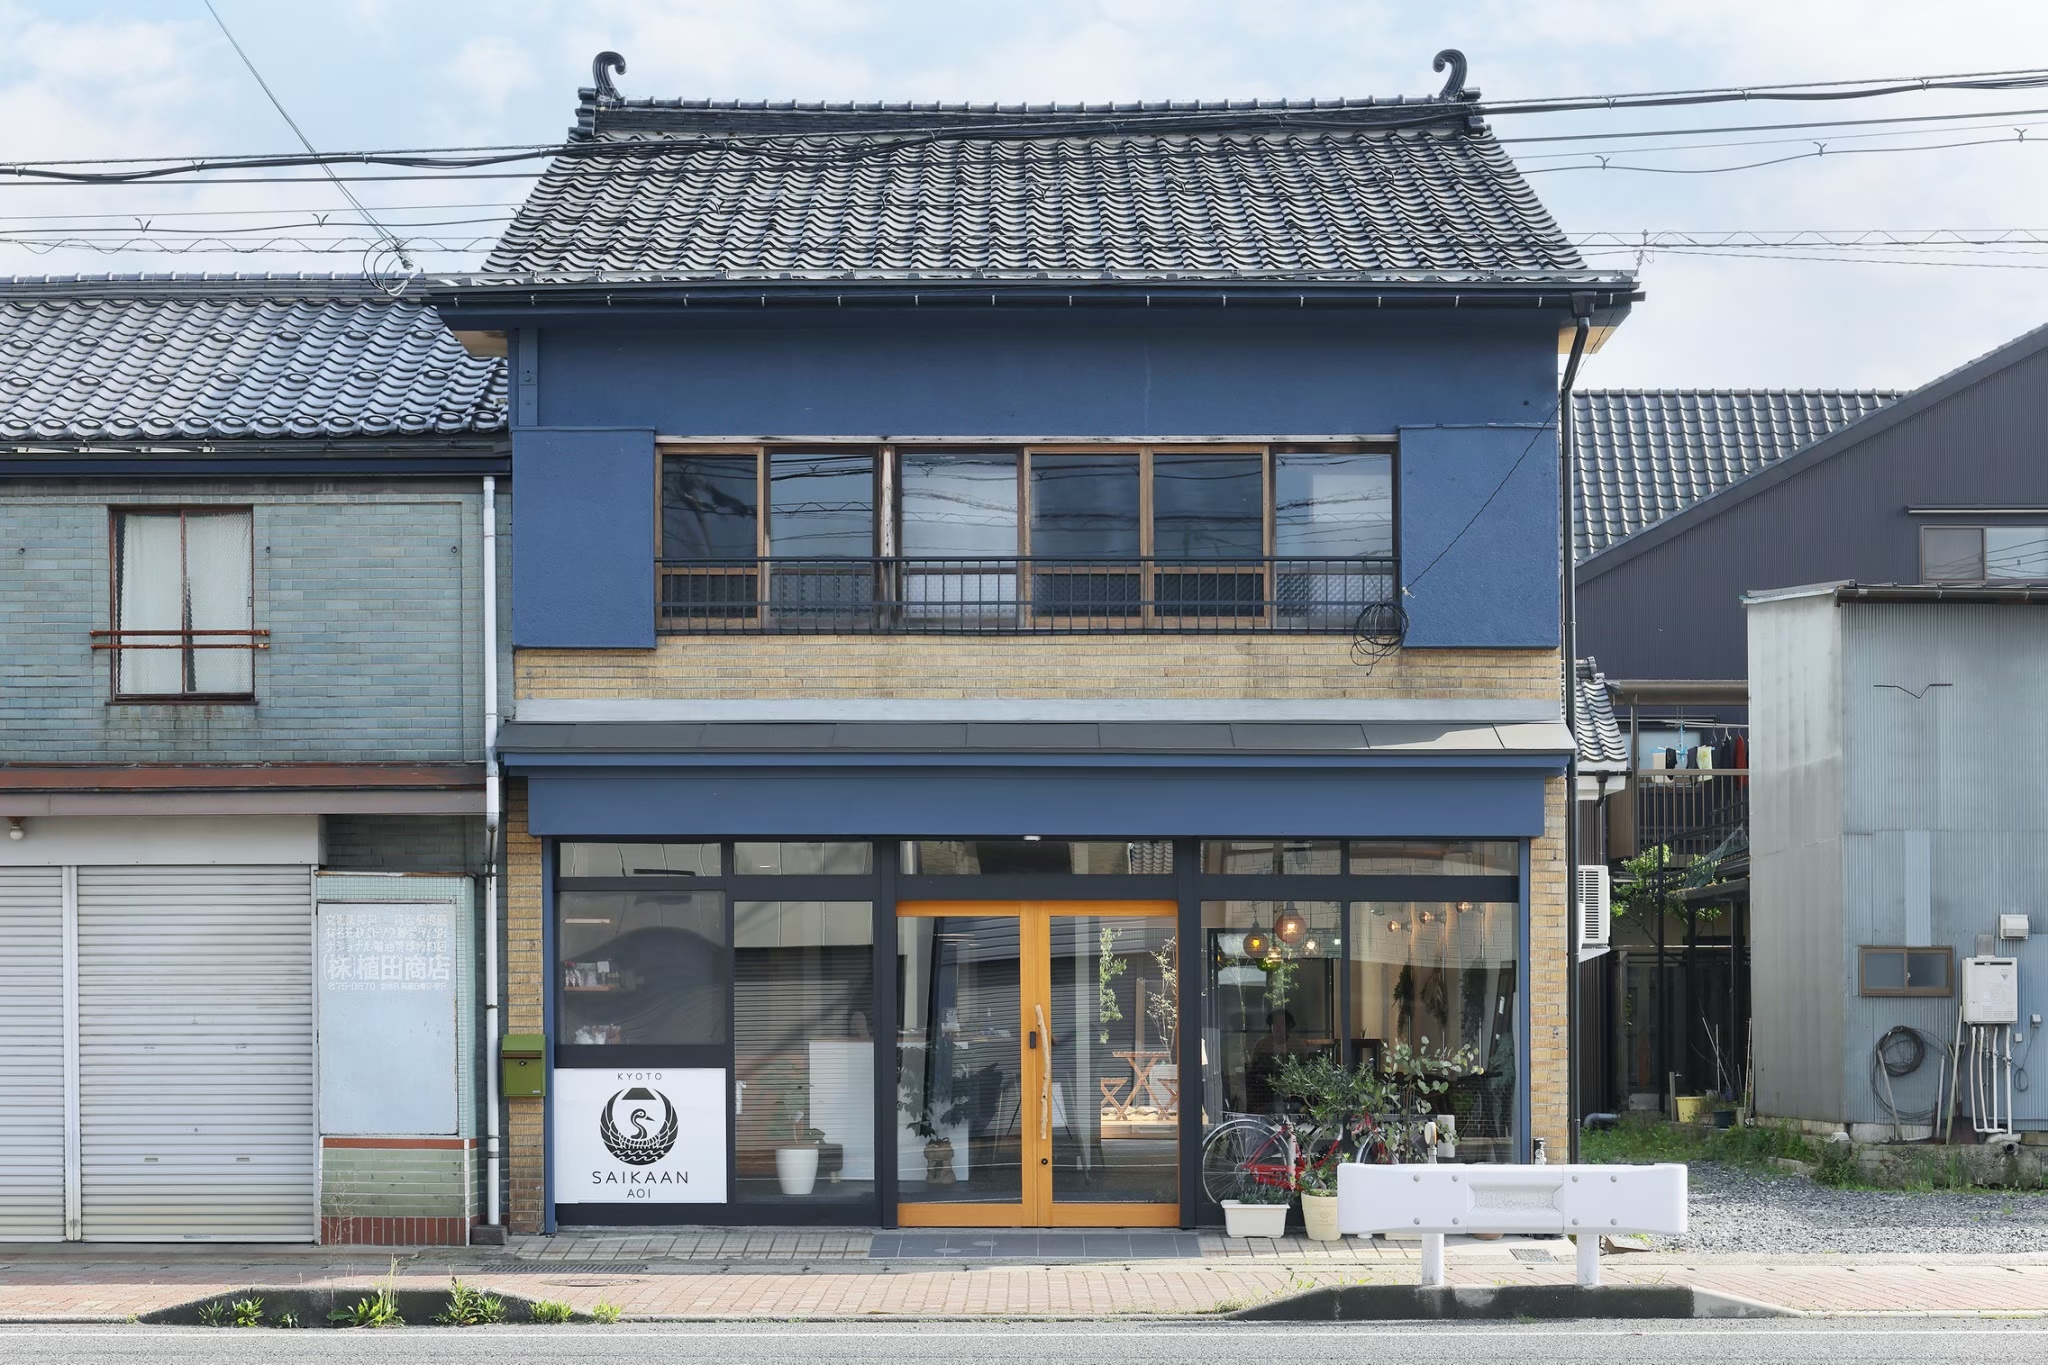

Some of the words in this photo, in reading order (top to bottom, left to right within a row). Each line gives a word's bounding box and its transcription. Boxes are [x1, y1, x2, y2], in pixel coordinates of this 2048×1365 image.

[617, 1072, 663, 1081] KYOTO
[591, 1170, 689, 1185] SAIKAAN
[626, 1188, 652, 1199] AOI
